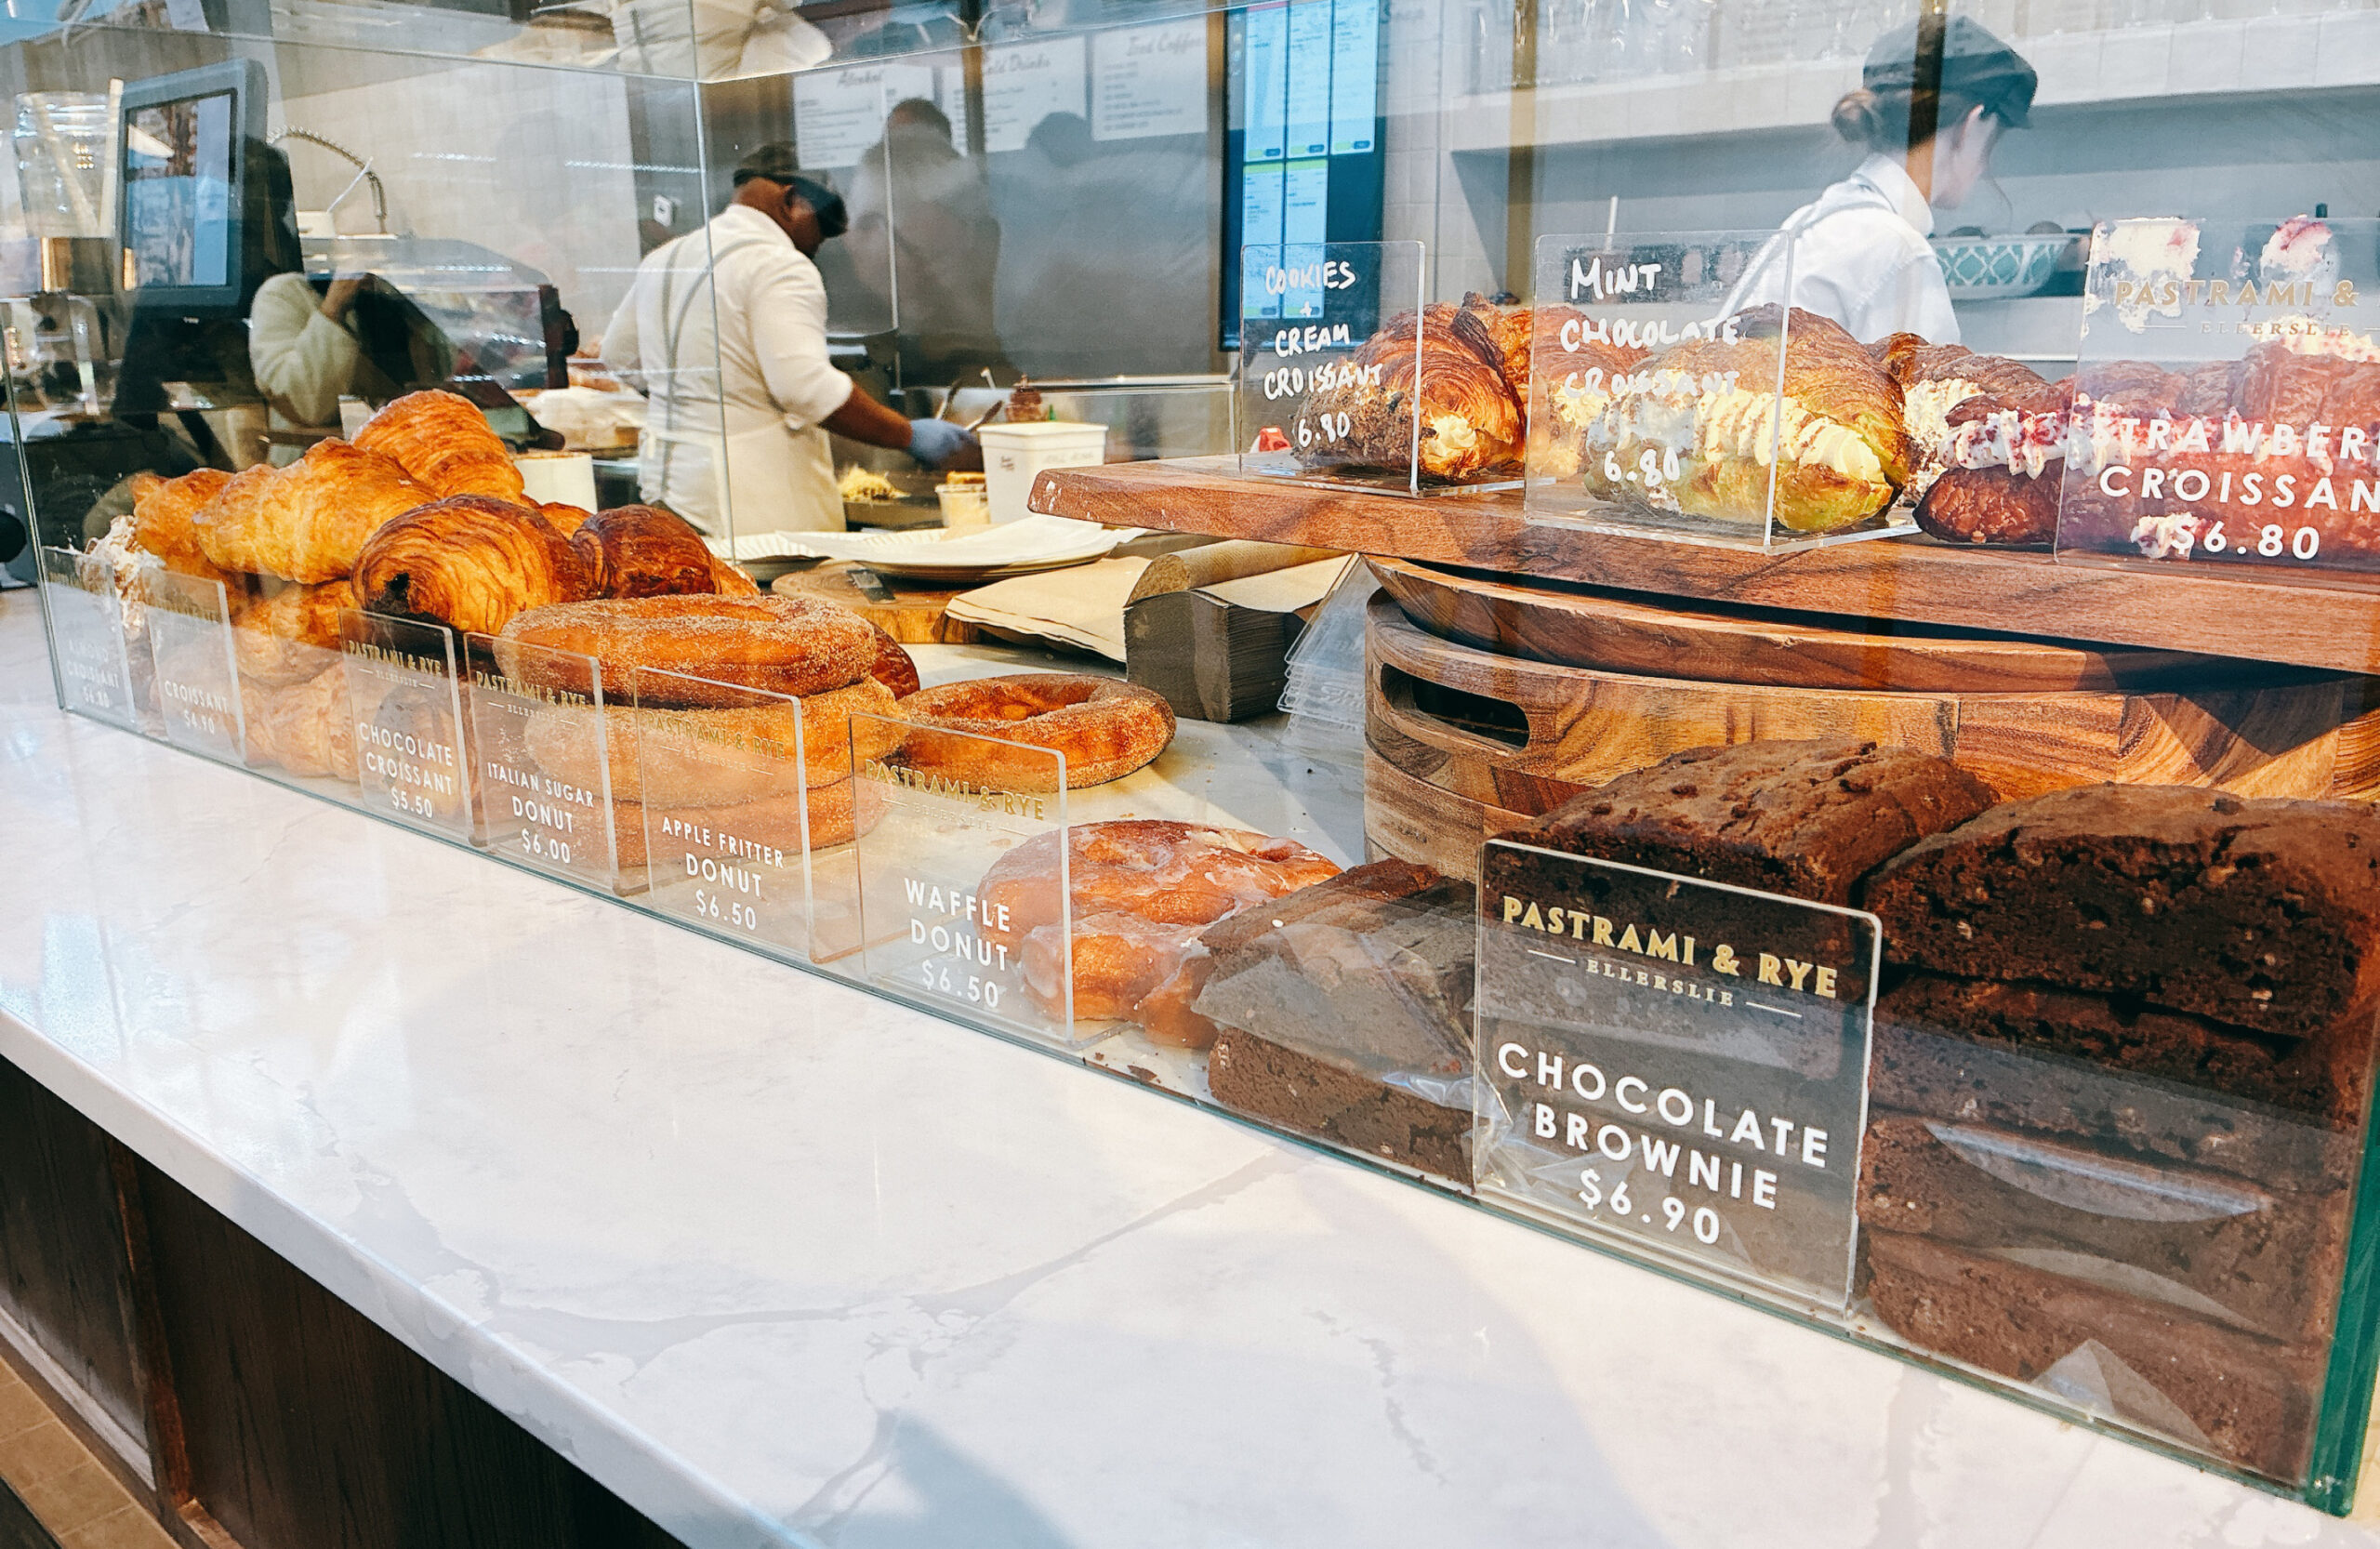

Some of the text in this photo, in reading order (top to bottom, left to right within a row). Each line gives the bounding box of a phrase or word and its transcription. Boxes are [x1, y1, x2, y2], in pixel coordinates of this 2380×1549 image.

[1265, 260, 1356, 296] COOKIES
[1570, 258, 1662, 300] MINT
[2114, 278, 2360, 308] PASTRAMI &
[1275, 324, 1351, 358] CREAM
[1560, 316, 1744, 353] CHOCOLATE
[1263, 363, 1384, 401] CROISSANT
[1564, 366, 1741, 400] CROISSANT
[2092, 417, 2380, 463] STRAWBER
[1604, 448, 1682, 488] 6.80
[2171, 519, 2320, 561] $6.80
[349, 640, 403, 669] PASTRAMI
[418, 656, 443, 678] RYE
[164, 680, 229, 714] CROISSANT
[476, 670, 541, 704] PASTRAMI
[560, 690, 587, 711] RYE
[359, 722, 454, 768] CHOCOLATE
[647, 710, 727, 748] PASTRAMI
[753, 736, 786, 761] RYE
[365, 751, 454, 797] CROISSANT
[486, 761, 595, 810] ITALIAN SUGAR
[865, 759, 1045, 821] PASTRAMI & RYE
[390, 785, 434, 820] $5.50
[512, 795, 574, 835] DONUT
[522, 827, 572, 865] $6.00
[661, 816, 785, 869] APPLE FRITTER
[685, 852, 763, 899] DONUT
[695, 890, 758, 931] $6.50
[904, 877, 1012, 933] WAFFLE
[910, 918, 1009, 973] DONUT
[1501, 894, 1839, 1000] PASTRAMI & RYE
[921, 959, 999, 1009] $6.50
[1585, 958, 1735, 1007] ELLERSLIE
[1498, 1041, 1829, 1169] CHOCOLATE
[1534, 1102, 1778, 1211] BROWNIE
[1579, 1167, 1720, 1245] $6.90
